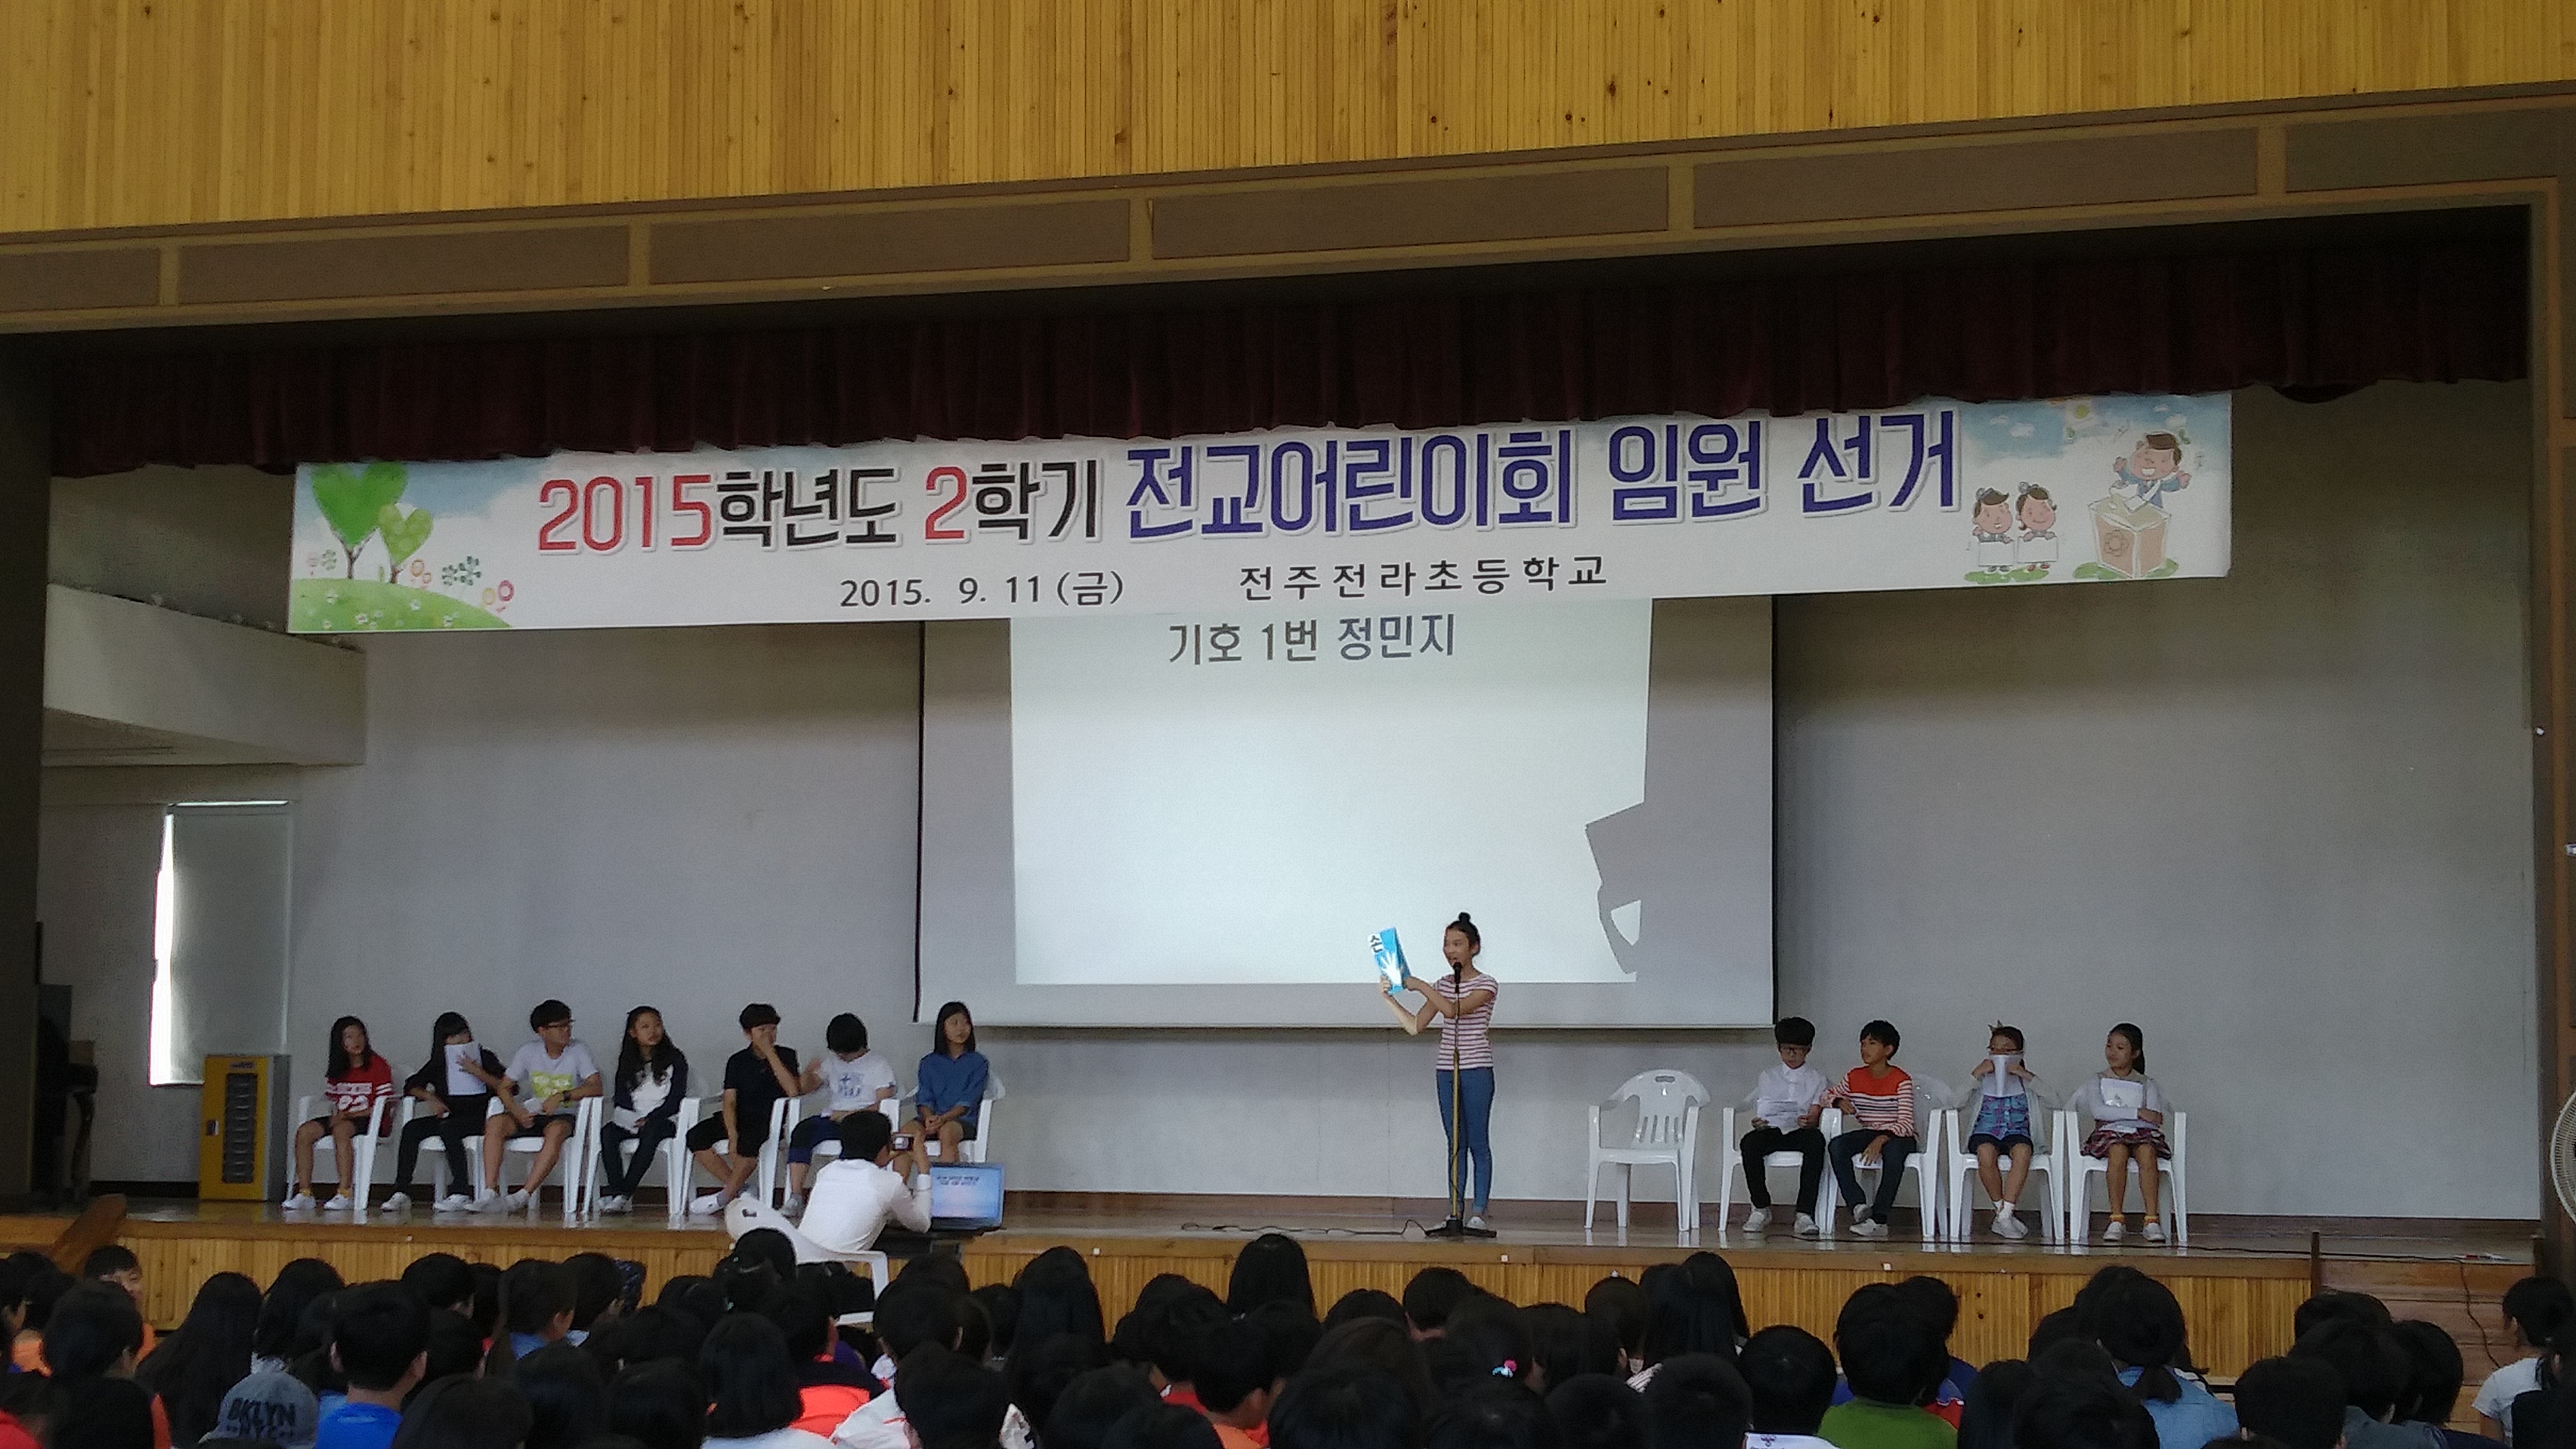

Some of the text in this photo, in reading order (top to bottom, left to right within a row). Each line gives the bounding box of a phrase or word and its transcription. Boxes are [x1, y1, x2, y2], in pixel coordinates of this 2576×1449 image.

[539, 411, 1954, 551] 2015학년도 2학기 전교어린이회 임원 선거
[840, 578, 931, 607] 2015.
[959, 577, 986, 604] 9.
[1240, 556, 1607, 601] 전주전라초등학교
[1170, 613, 1455, 665] 기호 1번 정민지
